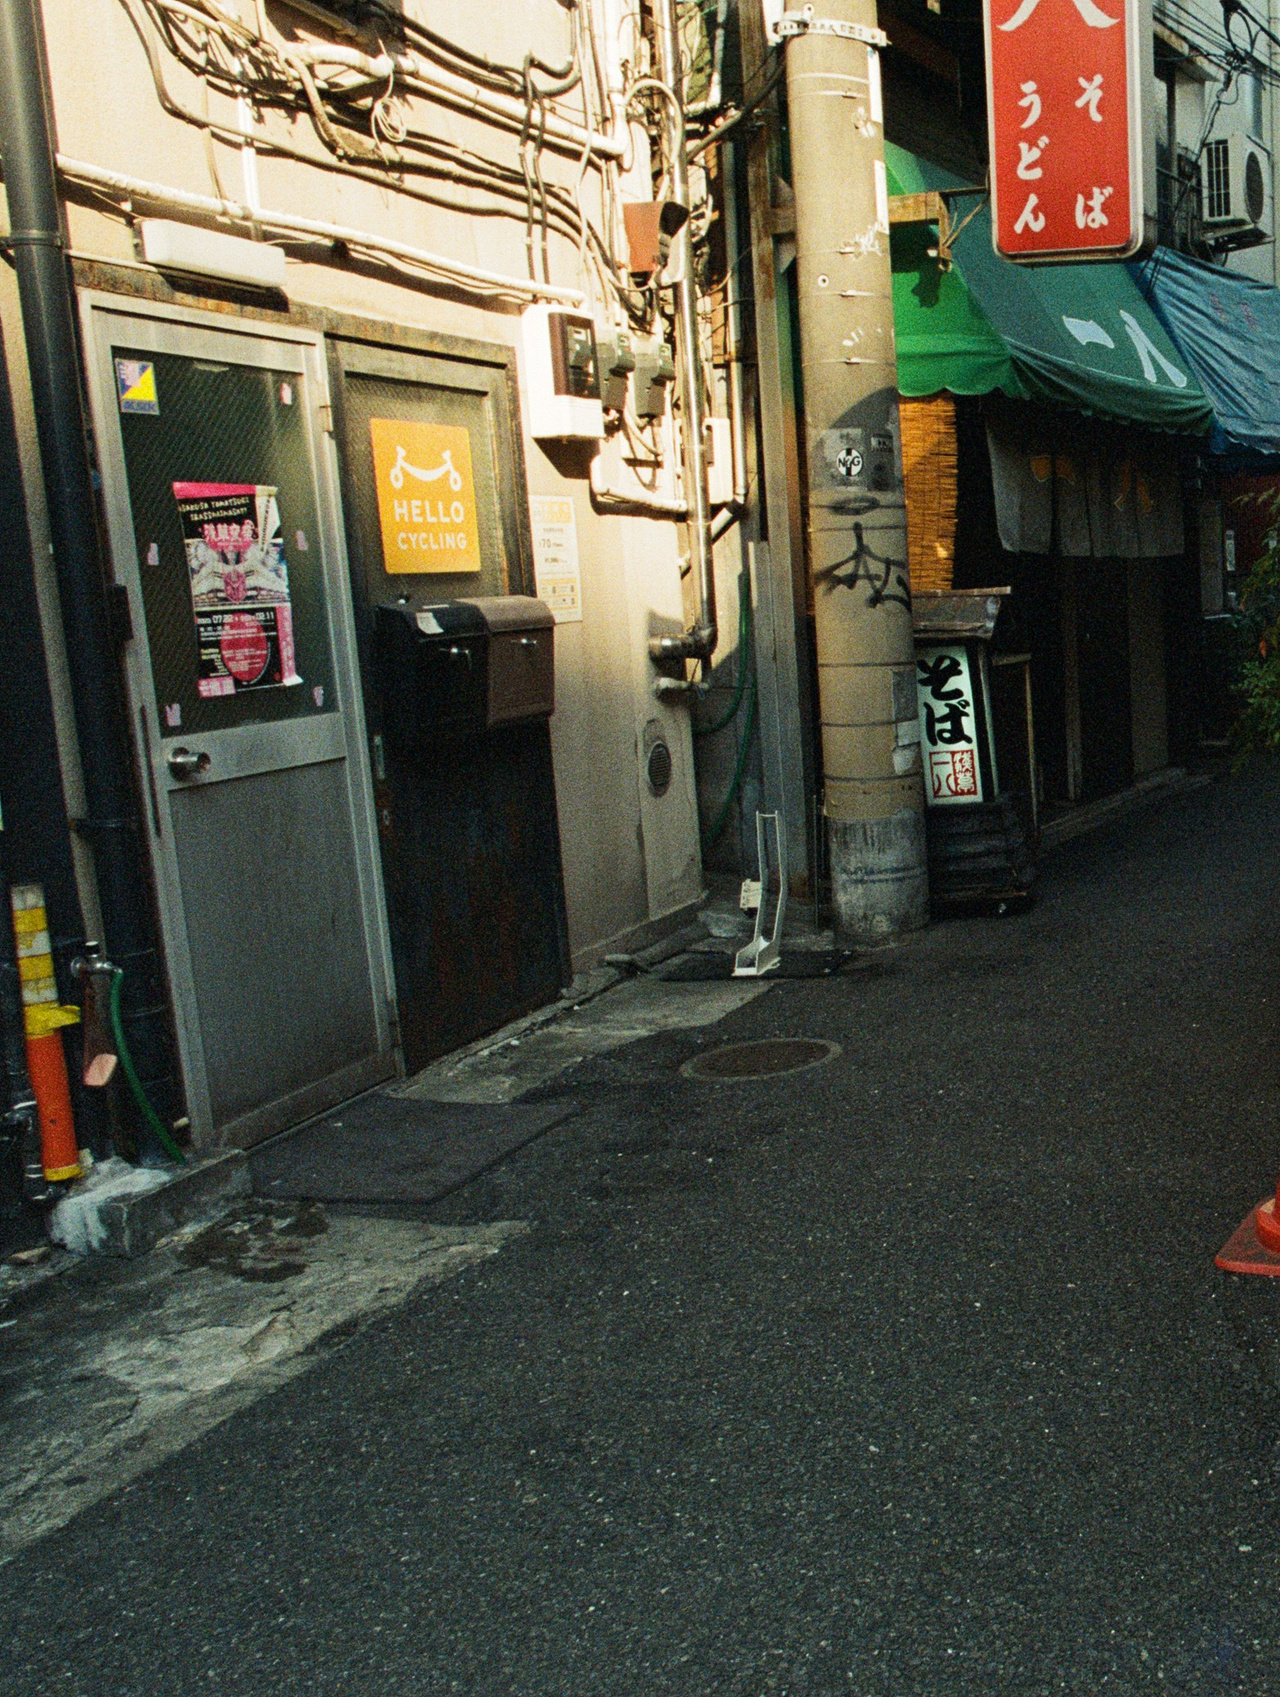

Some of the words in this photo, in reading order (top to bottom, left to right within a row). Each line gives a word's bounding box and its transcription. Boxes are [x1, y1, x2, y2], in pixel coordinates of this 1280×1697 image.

[1014, 81, 1050, 234] うどん
[1075, 74, 1113, 229] そば
[394, 500, 464, 523] HELLO
[397, 532, 467, 550] CYCLING
